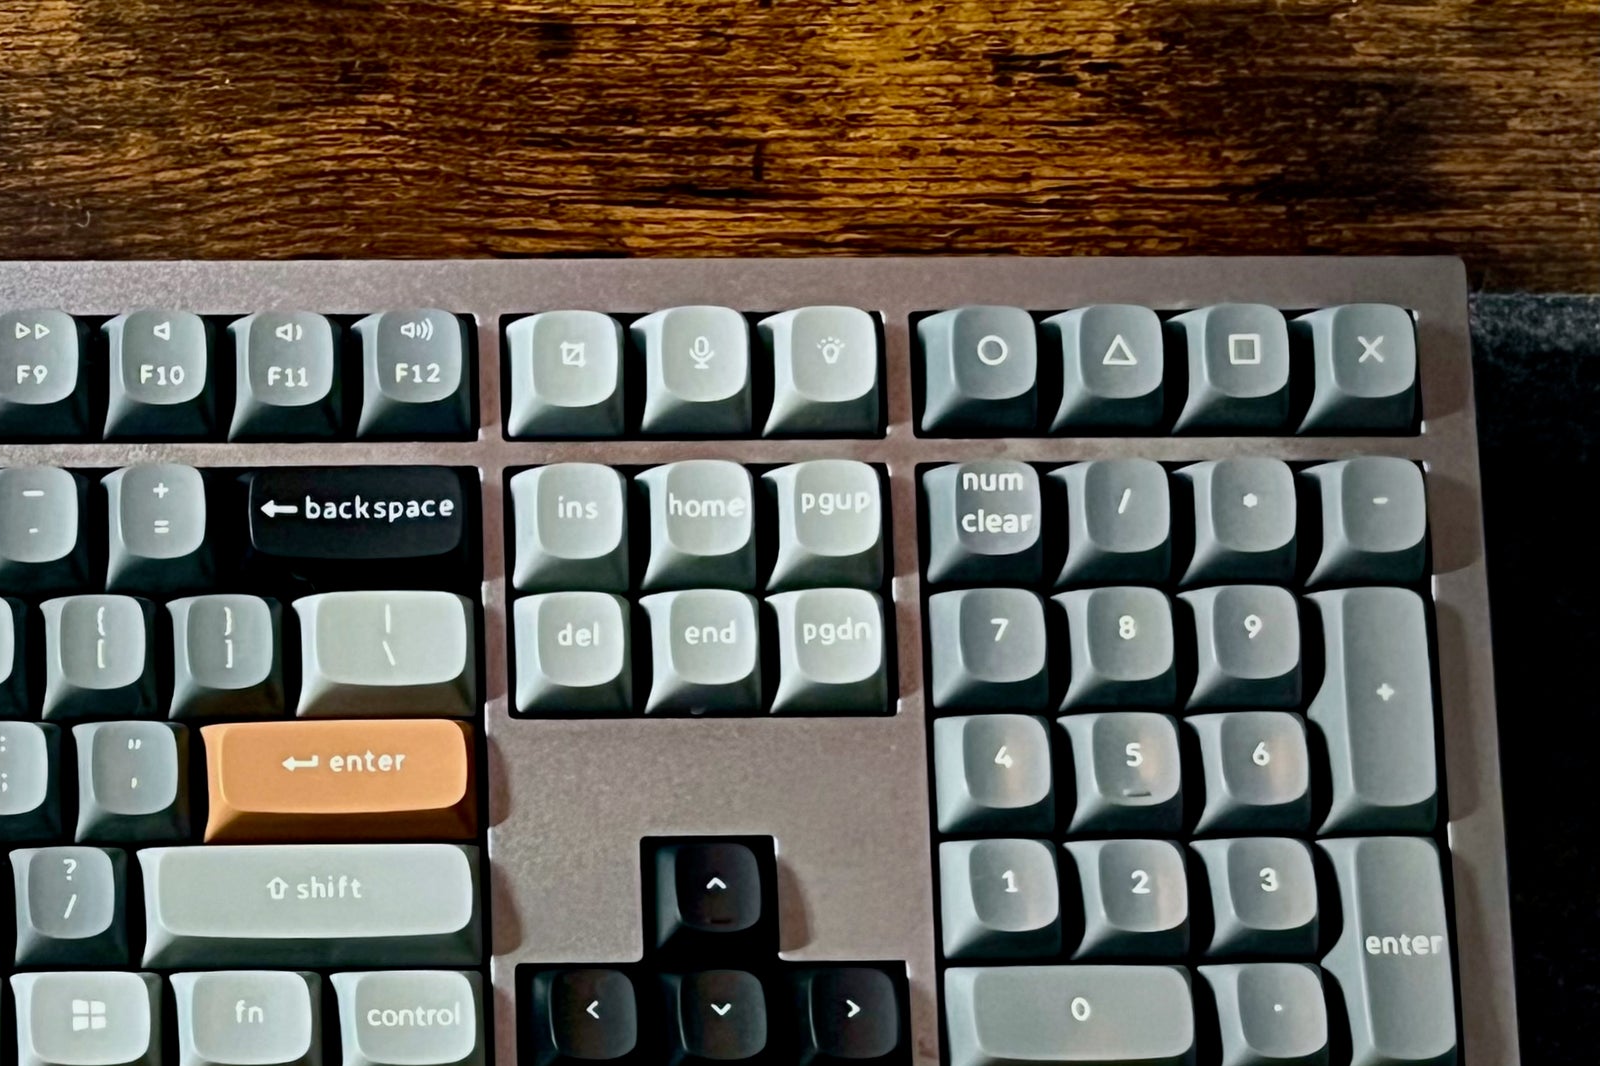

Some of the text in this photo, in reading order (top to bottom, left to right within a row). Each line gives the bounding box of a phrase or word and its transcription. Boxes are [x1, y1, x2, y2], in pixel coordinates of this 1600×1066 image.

[16, 365, 48, 384] F9
[140, 364, 184, 386] F10
[268, 366, 308, 388] F11
[396, 362, 440, 384] F12
[152, 482, 169, 498] +
[962, 472, 1024, 491] num
[305, 495, 454, 522] backspace
[558, 496, 598, 520] ins
[668, 493, 745, 517] home
[801, 490, 871, 515] pgup
[1118, 488, 1132, 514] /
[154, 520, 170, 533] =
[962, 509, 1032, 534] clear
[97, 606, 106, 636] {
[224, 606, 232, 636] }
[684, 620, 736, 646] end
[802, 618, 873, 644] pgdn
[990, 618, 1008, 642] 7
[1118, 616, 1136, 639] 8
[1244, 615, 1262, 638] 9
[558, 622, 600, 646] del
[98, 638, 106, 668] [
[224, 638, 233, 668] ]
[382, 640, 396, 666] \
[1376, 682, 1395, 702] +
[0, 736, 6, 752] :
[1126, 743, 1143, 768] 5
[1252, 742, 1270, 766] 6
[330, 751, 406, 772] enter
[994, 746, 1013, 768] 4
[0, 772, 8, 792] ;
[63, 858, 78, 880] ?
[1002, 870, 1018, 892] 1
[1260, 868, 1278, 892] 3
[296, 876, 362, 900] shift
[1132, 870, 1150, 894] 2
[64, 894, 78, 918] /
[1366, 933, 1443, 956] enter
[234, 1000, 264, 1024] fn
[367, 1002, 460, 1026] control
[1071, 997, 1090, 1022] 0
